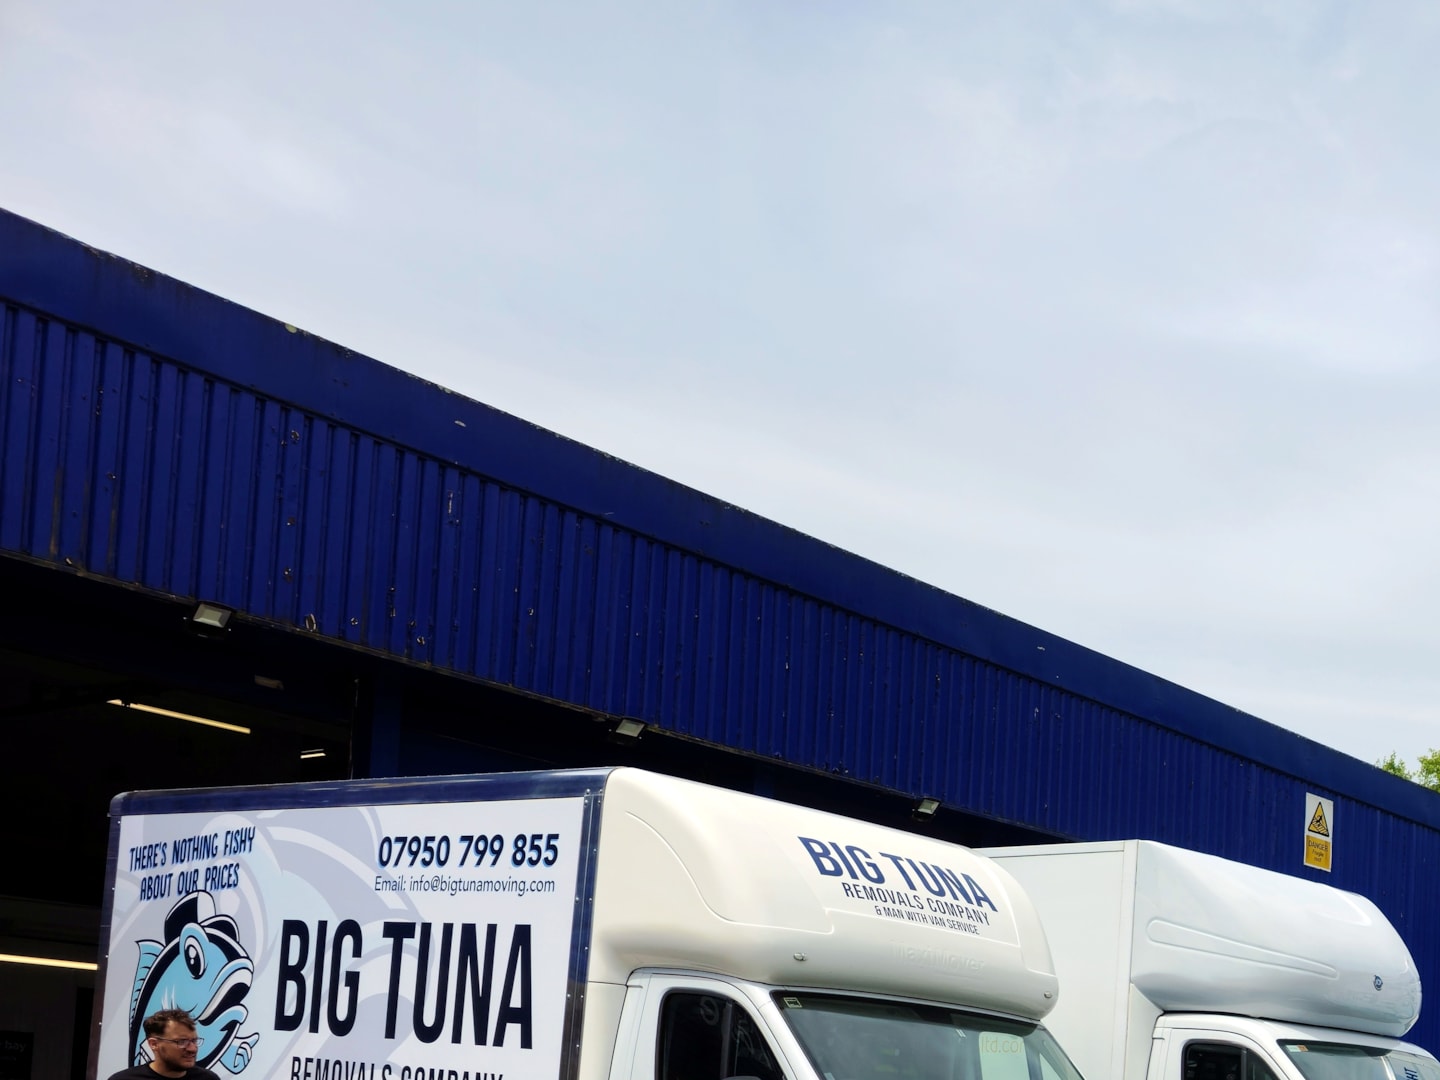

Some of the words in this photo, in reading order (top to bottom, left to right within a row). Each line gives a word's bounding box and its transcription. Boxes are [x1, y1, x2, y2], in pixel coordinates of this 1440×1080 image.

[129, 842, 167, 872] THERE'S
[171, 832, 218, 864] NOTHING
[223, 826, 256, 857] FISHY
[378, 835, 450, 868] 07950
[458, 834, 504, 867] 799
[511, 833, 560, 868] 855
[140, 873, 174, 901] ABOUT
[177, 868, 199, 895] OUR
[204, 862, 240, 892] PRICES
[374, 875, 406, 892] Email:
[409, 875, 555, 897] info@bigtunamoving.com
[797, 836, 885, 884] BIG
[878, 852, 998, 912] TUNA
[842, 882, 924, 910] REMOVALS
[927, 897, 991, 926] COMPANY
[875, 905, 882, 916] &
[883, 906, 905, 920] MAN
[905, 911, 928, 924] WITH
[929, 915, 947, 927] VAN
[947, 919, 980, 935] SERVICE
[273, 919, 363, 1037] BIG
[382, 921, 533, 1050] TUNA
